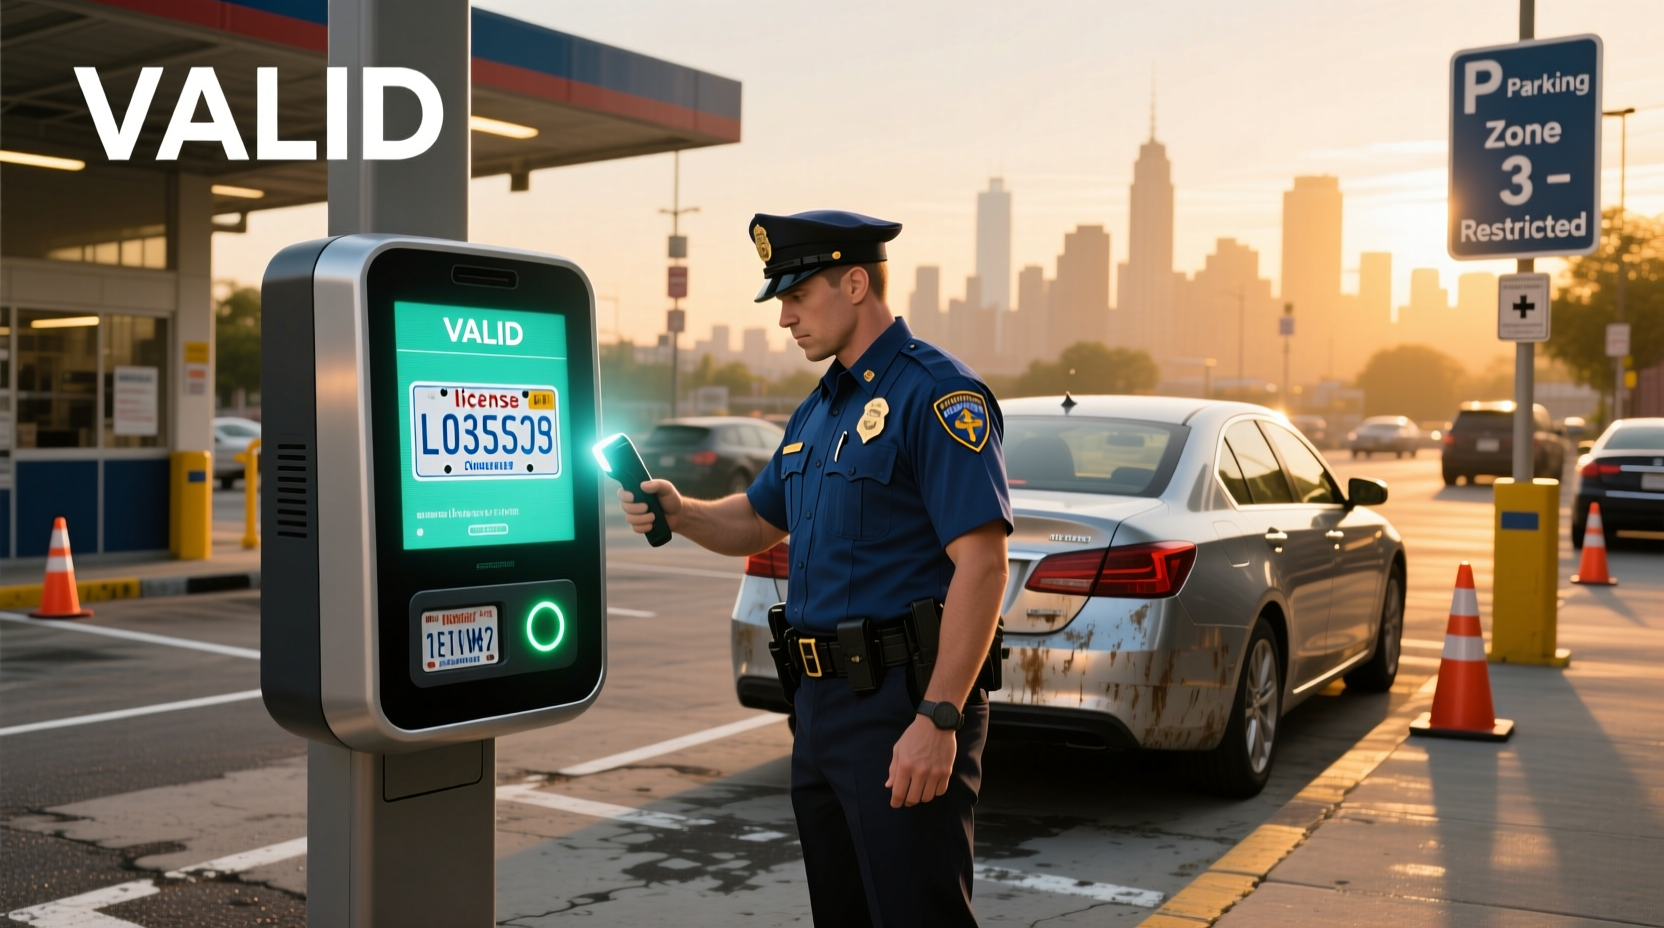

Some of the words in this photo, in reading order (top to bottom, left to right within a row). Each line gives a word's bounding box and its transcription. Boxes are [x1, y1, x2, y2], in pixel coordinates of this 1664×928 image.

[1464, 60, 1503, 115] P
[1507, 71, 1590, 98] Parking
[1484, 120, 1562, 149] Zone
[1499, 155, 1533, 206] 3
[1460, 211, 1587, 243] Restricted
[443, 317, 524, 346] VALID
[454, 388, 519, 409] license
